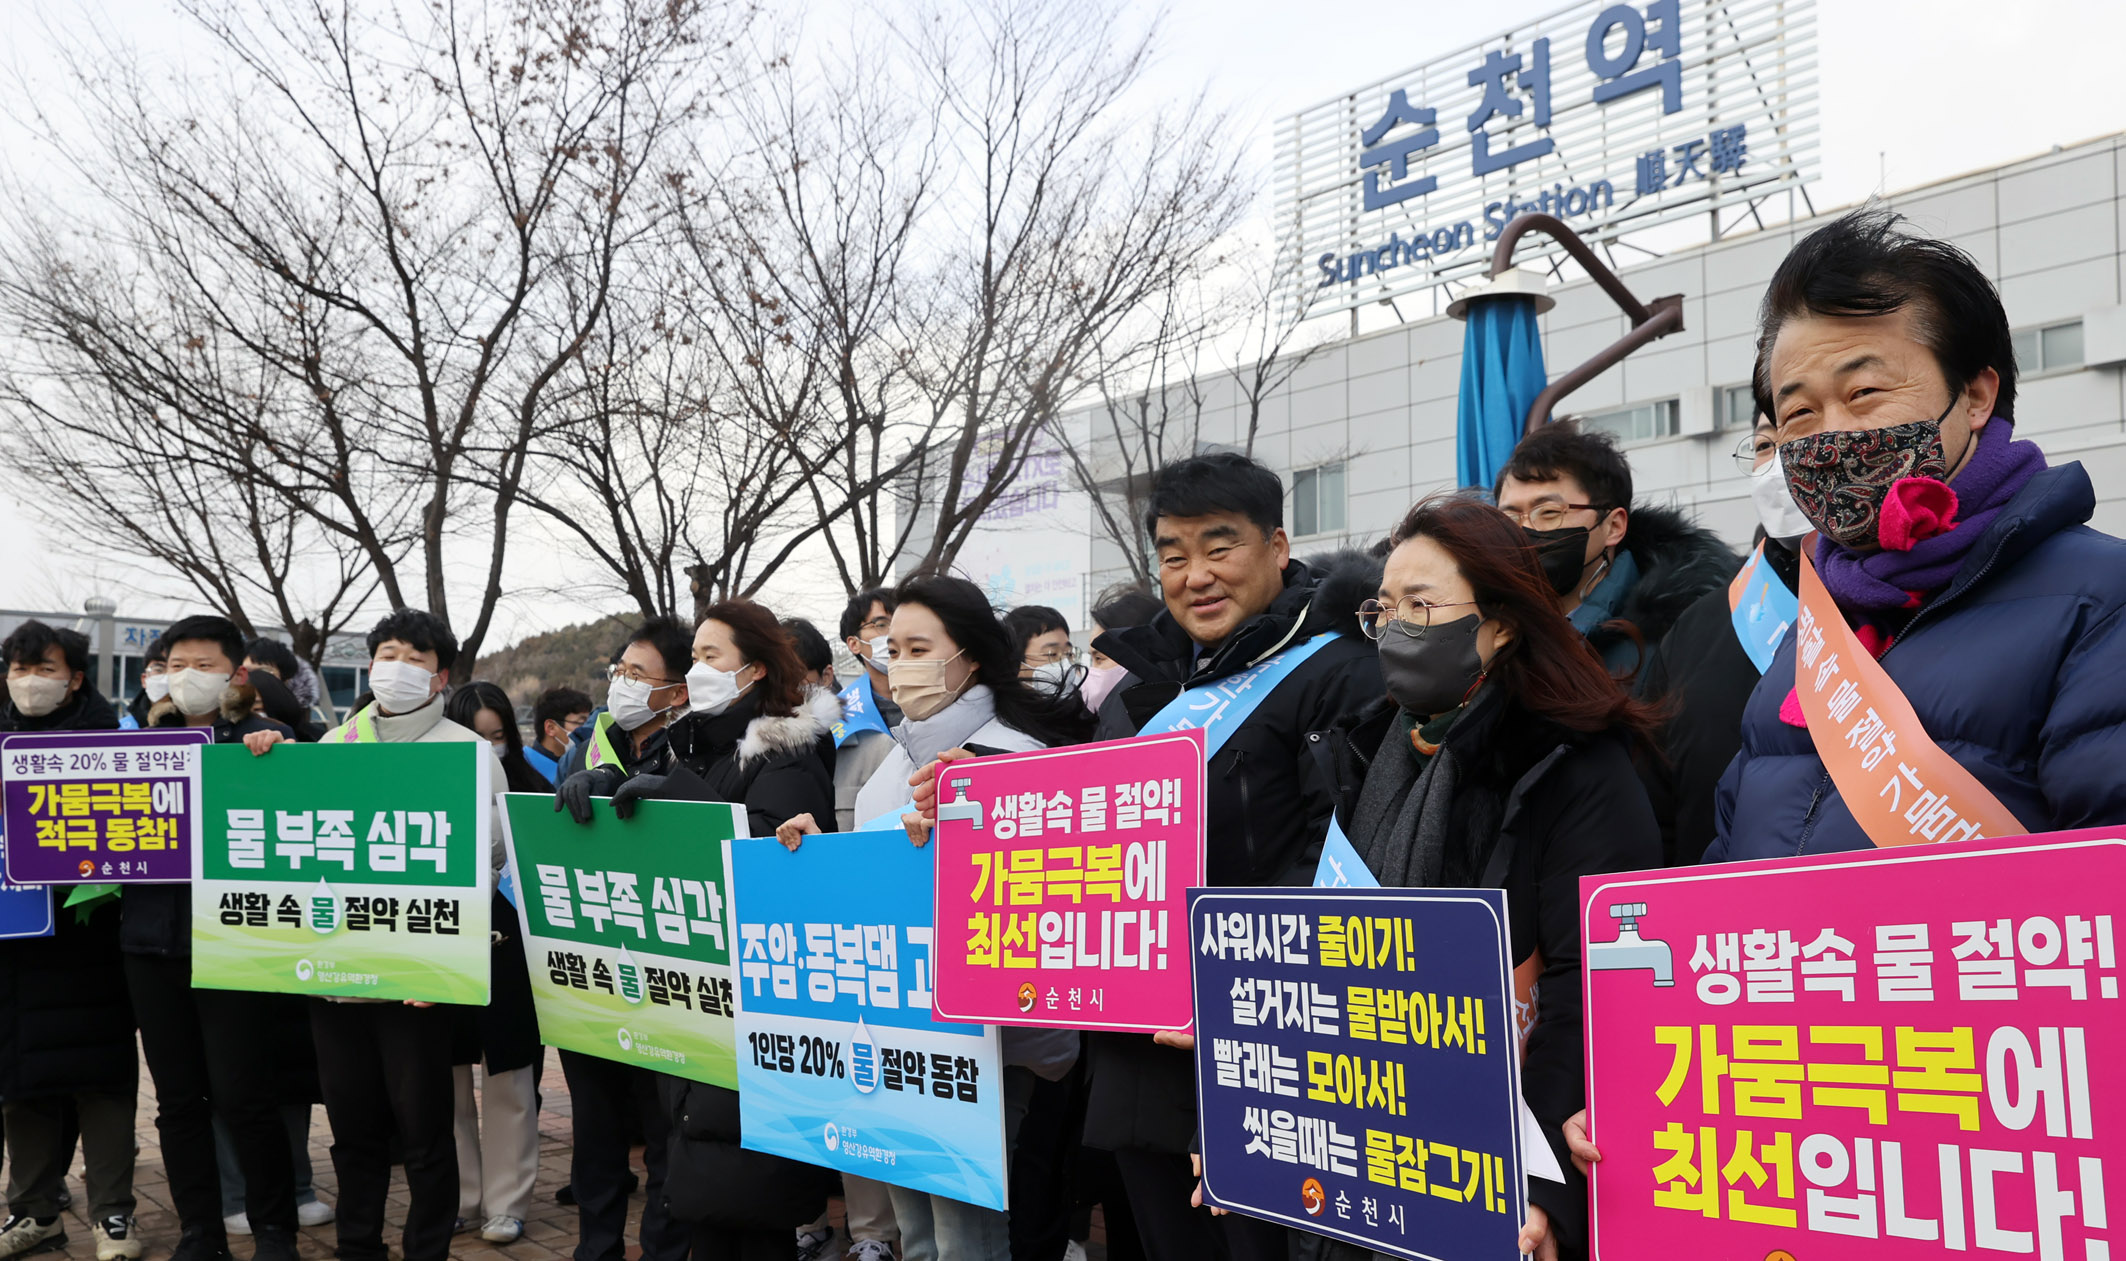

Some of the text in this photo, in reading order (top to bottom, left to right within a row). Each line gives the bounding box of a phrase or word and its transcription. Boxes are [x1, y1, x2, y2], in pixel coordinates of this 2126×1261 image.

[1359, 0, 1682, 212] 순천역
[1635, 123, 1748, 198] 順天驛
[1317, 218, 1474, 289] Suncheon
[125, 626, 161, 647] 자
[1797, 604, 1827, 669] 생활
[1814, 651, 1840, 694] 속
[1826, 680, 1863, 724] 물
[12, 750, 192, 775] 생활속 20% 물 절약실
[1844, 706, 1897, 773] 절약
[27, 781, 185, 817] 가뭄극복에
[990, 778, 1182, 840] 생활속 물 절약!
[36, 818, 98, 852] 적극
[105, 816, 178, 852] 동참!
[226, 808, 452, 873] 물 부족 심각
[970, 840, 1167, 906] 가뭄극복에
[219, 892, 460, 935] 생활 속 물 절약 실천
[536, 864, 726, 951] 물 부족 심각
[966, 909, 1168, 971] 최선입니다!
[1200, 911, 1416, 972] 샤워시간 줄이기!
[1688, 914, 2119, 1006] 생활속 물 절약!
[547, 950, 589, 991] 생활
[592, 958, 615, 996] 속
[617, 962, 641, 1001] 물
[644, 966, 692, 1011] 절약
[1229, 977, 1340, 1036] 설거지는
[1346, 985, 1487, 1055] 물받아서!
[748, 1032, 979, 1104] 1인당 20% 물 절약 동참
[1213, 1037, 1407, 1117] 빨래는 모아서!
[1654, 1024, 2094, 1141] 가뭄극복에
[842, 1140, 897, 1166] 영산강유역환경청
[1242, 1105, 1507, 1215] 씻을때는 물잠그기!
[1652, 1121, 2112, 1261] 최선입니다!
